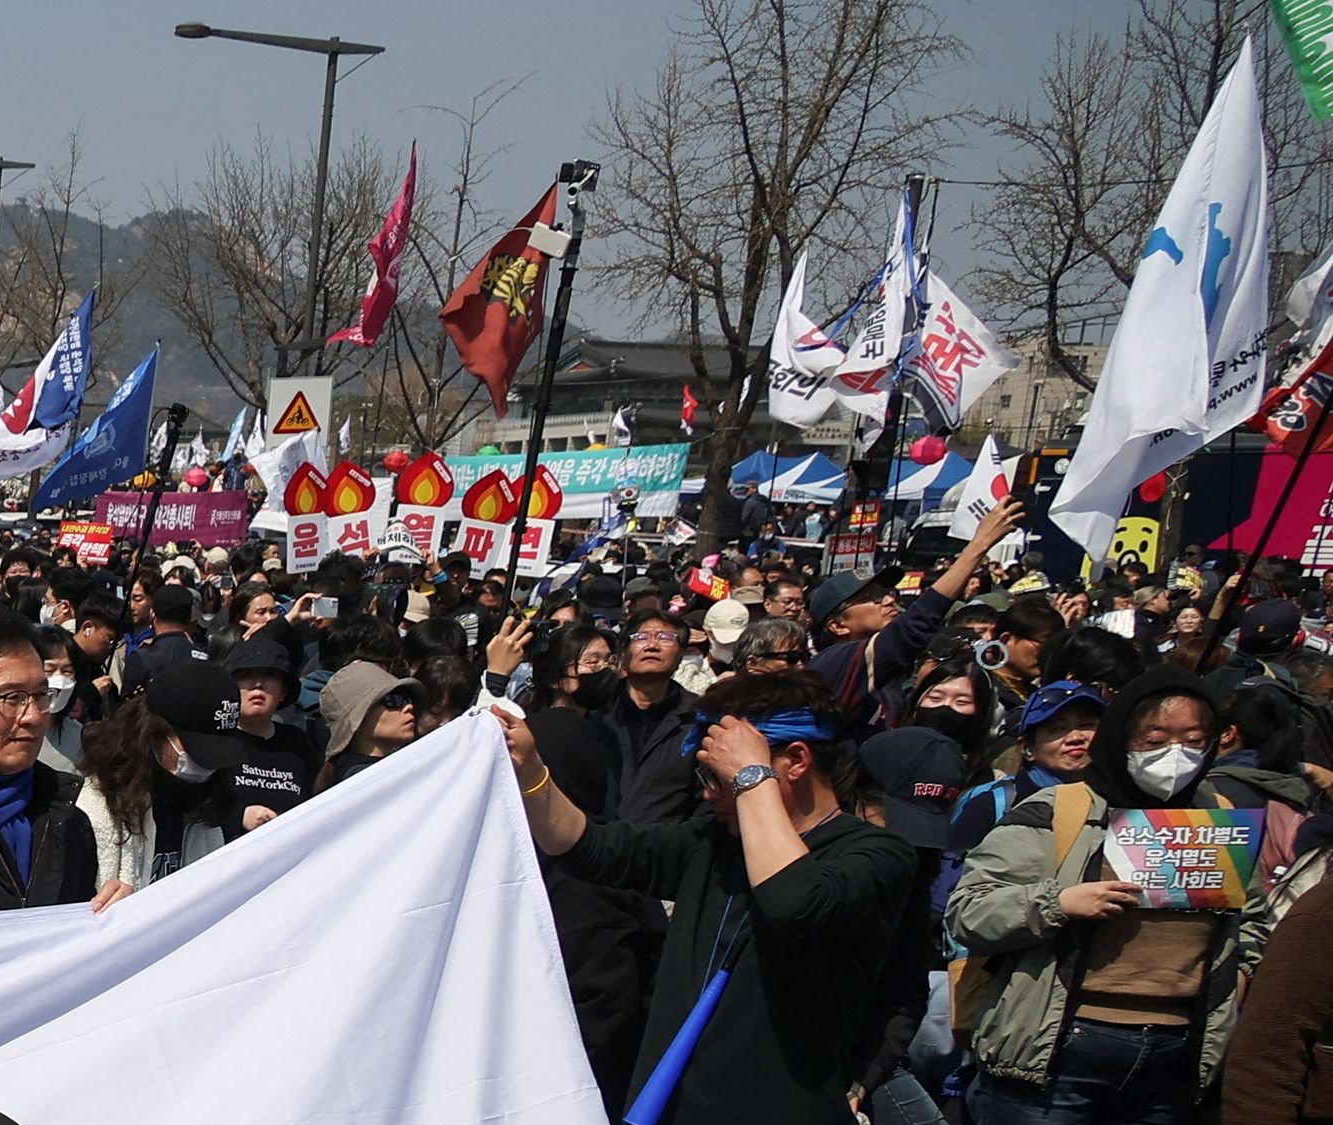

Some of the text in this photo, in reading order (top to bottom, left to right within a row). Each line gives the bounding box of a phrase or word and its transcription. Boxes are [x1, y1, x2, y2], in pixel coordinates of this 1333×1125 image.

[293, 522, 318, 558] 윤
[337, 519, 370, 556] 석
[464, 526, 494, 563] 파
[242, 764, 294, 780] Saturdays
[235, 776, 301, 795] NewYorkCity
[1117, 826, 1250, 845] 성소수자 차별도
[1144, 849, 1218, 867] 윤석열도
[1132, 871, 1224, 889] 없는 사회로
